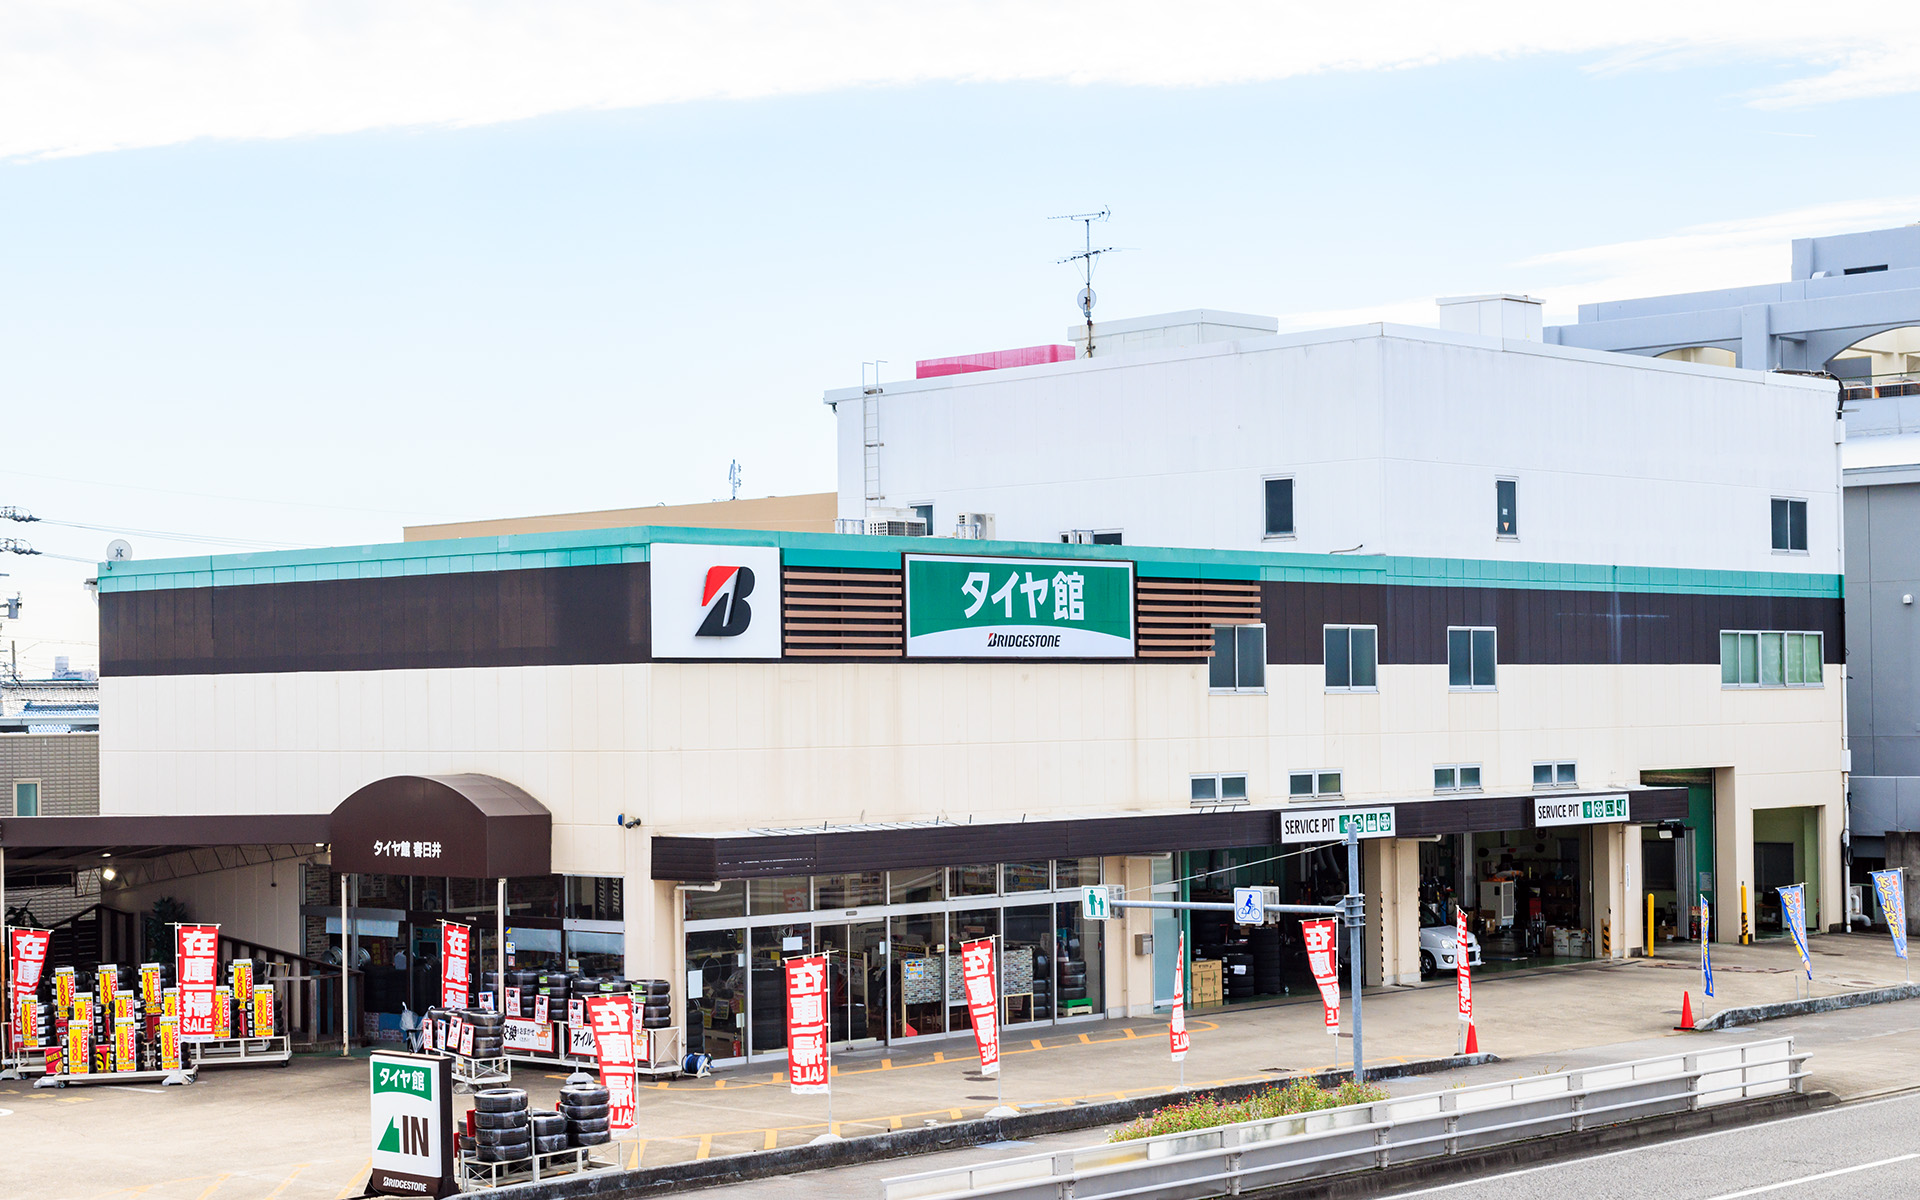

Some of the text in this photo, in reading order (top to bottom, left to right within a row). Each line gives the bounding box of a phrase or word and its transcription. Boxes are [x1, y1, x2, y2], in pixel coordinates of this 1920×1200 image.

[961, 571, 1084, 620] タイヤ館
[987, 633, 1061, 647] BRIDGESTONE
[1538, 804, 1579, 819] SERVICE PIT
[1285, 818, 1335, 835] SERVICE PIT
[373, 840, 441, 858] タイヤ館 春日井
[182, 930, 215, 1018] 在庫一掃
[183, 1018, 212, 1032] SALE
[573, 1030, 596, 1048] オイル
[379, 1067, 425, 1092] タイヤ館
[402, 1115, 429, 1157] IN
[383, 1176, 427, 1192] BRIDGESTONE
